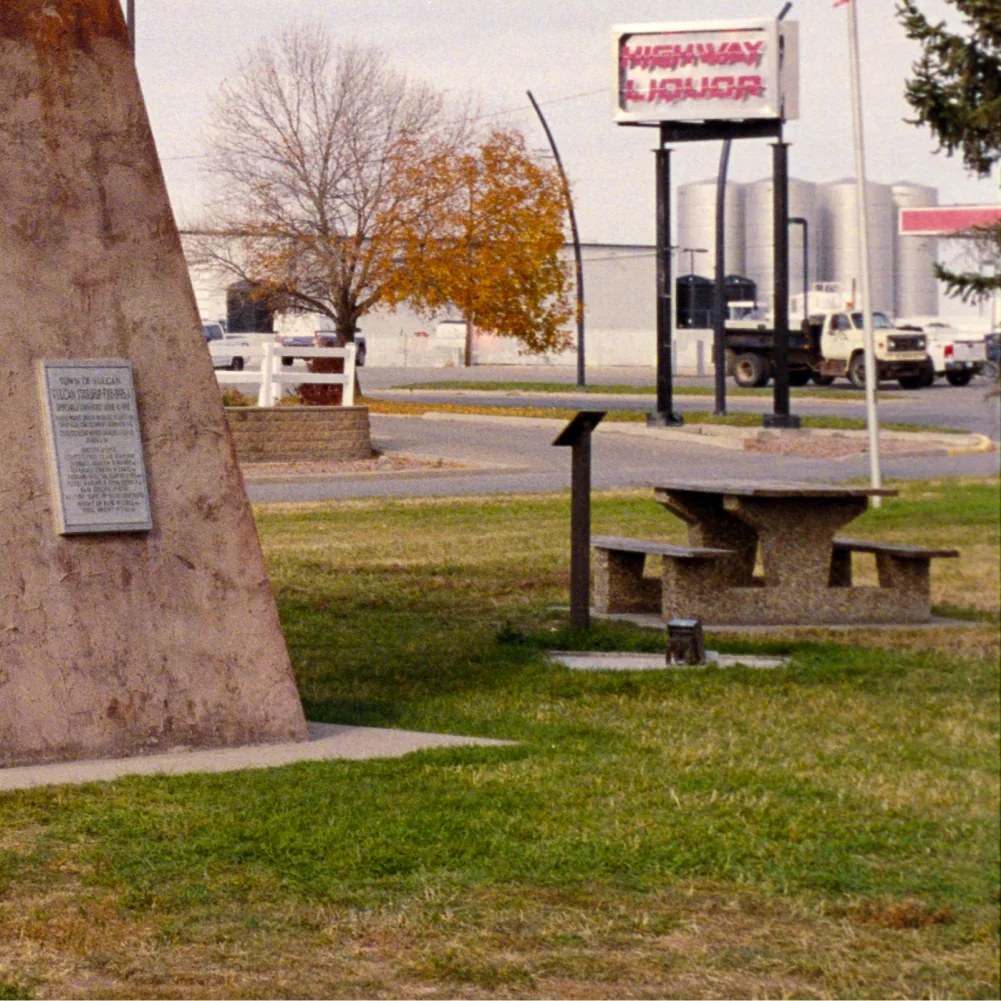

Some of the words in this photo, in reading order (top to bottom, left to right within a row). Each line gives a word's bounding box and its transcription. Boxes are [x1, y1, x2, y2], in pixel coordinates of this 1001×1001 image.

[621, 41, 764, 70] HIGHWAY
[624, 75, 764, 103] LIQUOR
[92, 375, 121, 385] VULCAN
